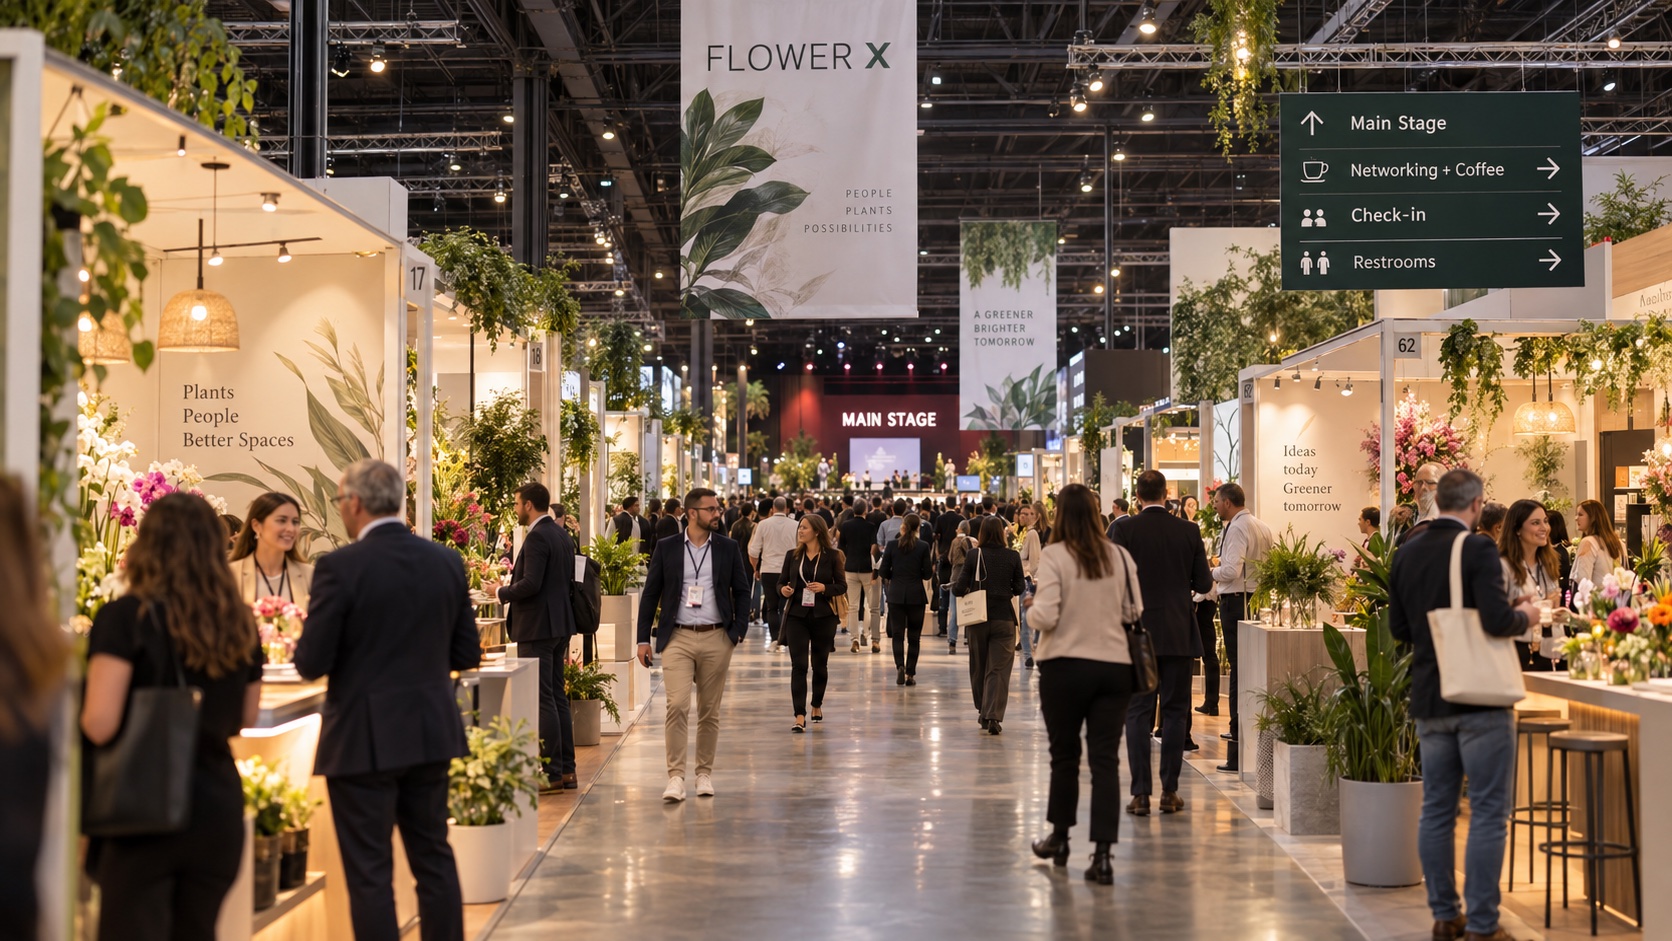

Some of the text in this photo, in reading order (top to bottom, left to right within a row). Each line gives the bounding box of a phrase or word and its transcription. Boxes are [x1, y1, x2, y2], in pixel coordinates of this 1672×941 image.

[707, 42, 891, 72] FLOWER X
[1351, 115, 1447, 135] Main Stage
[1351, 162, 1438, 181] Networking
[1455, 161, 1505, 177] Coffee
[845, 189, 893, 199] PEOPLE
[845, 206, 892, 216] PLANTS
[1351, 206, 1426, 223] Check-in
[803, 223, 893, 234] POSSIBILITIES
[1353, 254, 1436, 269] Restrooms
[410, 266, 426, 291] 17
[973, 310, 1034, 320] A GREENER
[973, 323, 1026, 333] BRIGHTER
[973, 337, 1035, 347] TOMORROW
[1397, 337, 1416, 353] 62
[531, 347, 542, 365] 18
[183, 383, 235, 400] Plants
[183, 407, 240, 428] People
[842, 412, 937, 427] MAIN STAGE
[183, 432, 294, 452] Better Spaces
[1283, 444, 1317, 457] Ideas
[1283, 462, 1318, 478] today
[1283, 482, 1333, 494] Greener
[1284, 500, 1342, 512] tomorrow
